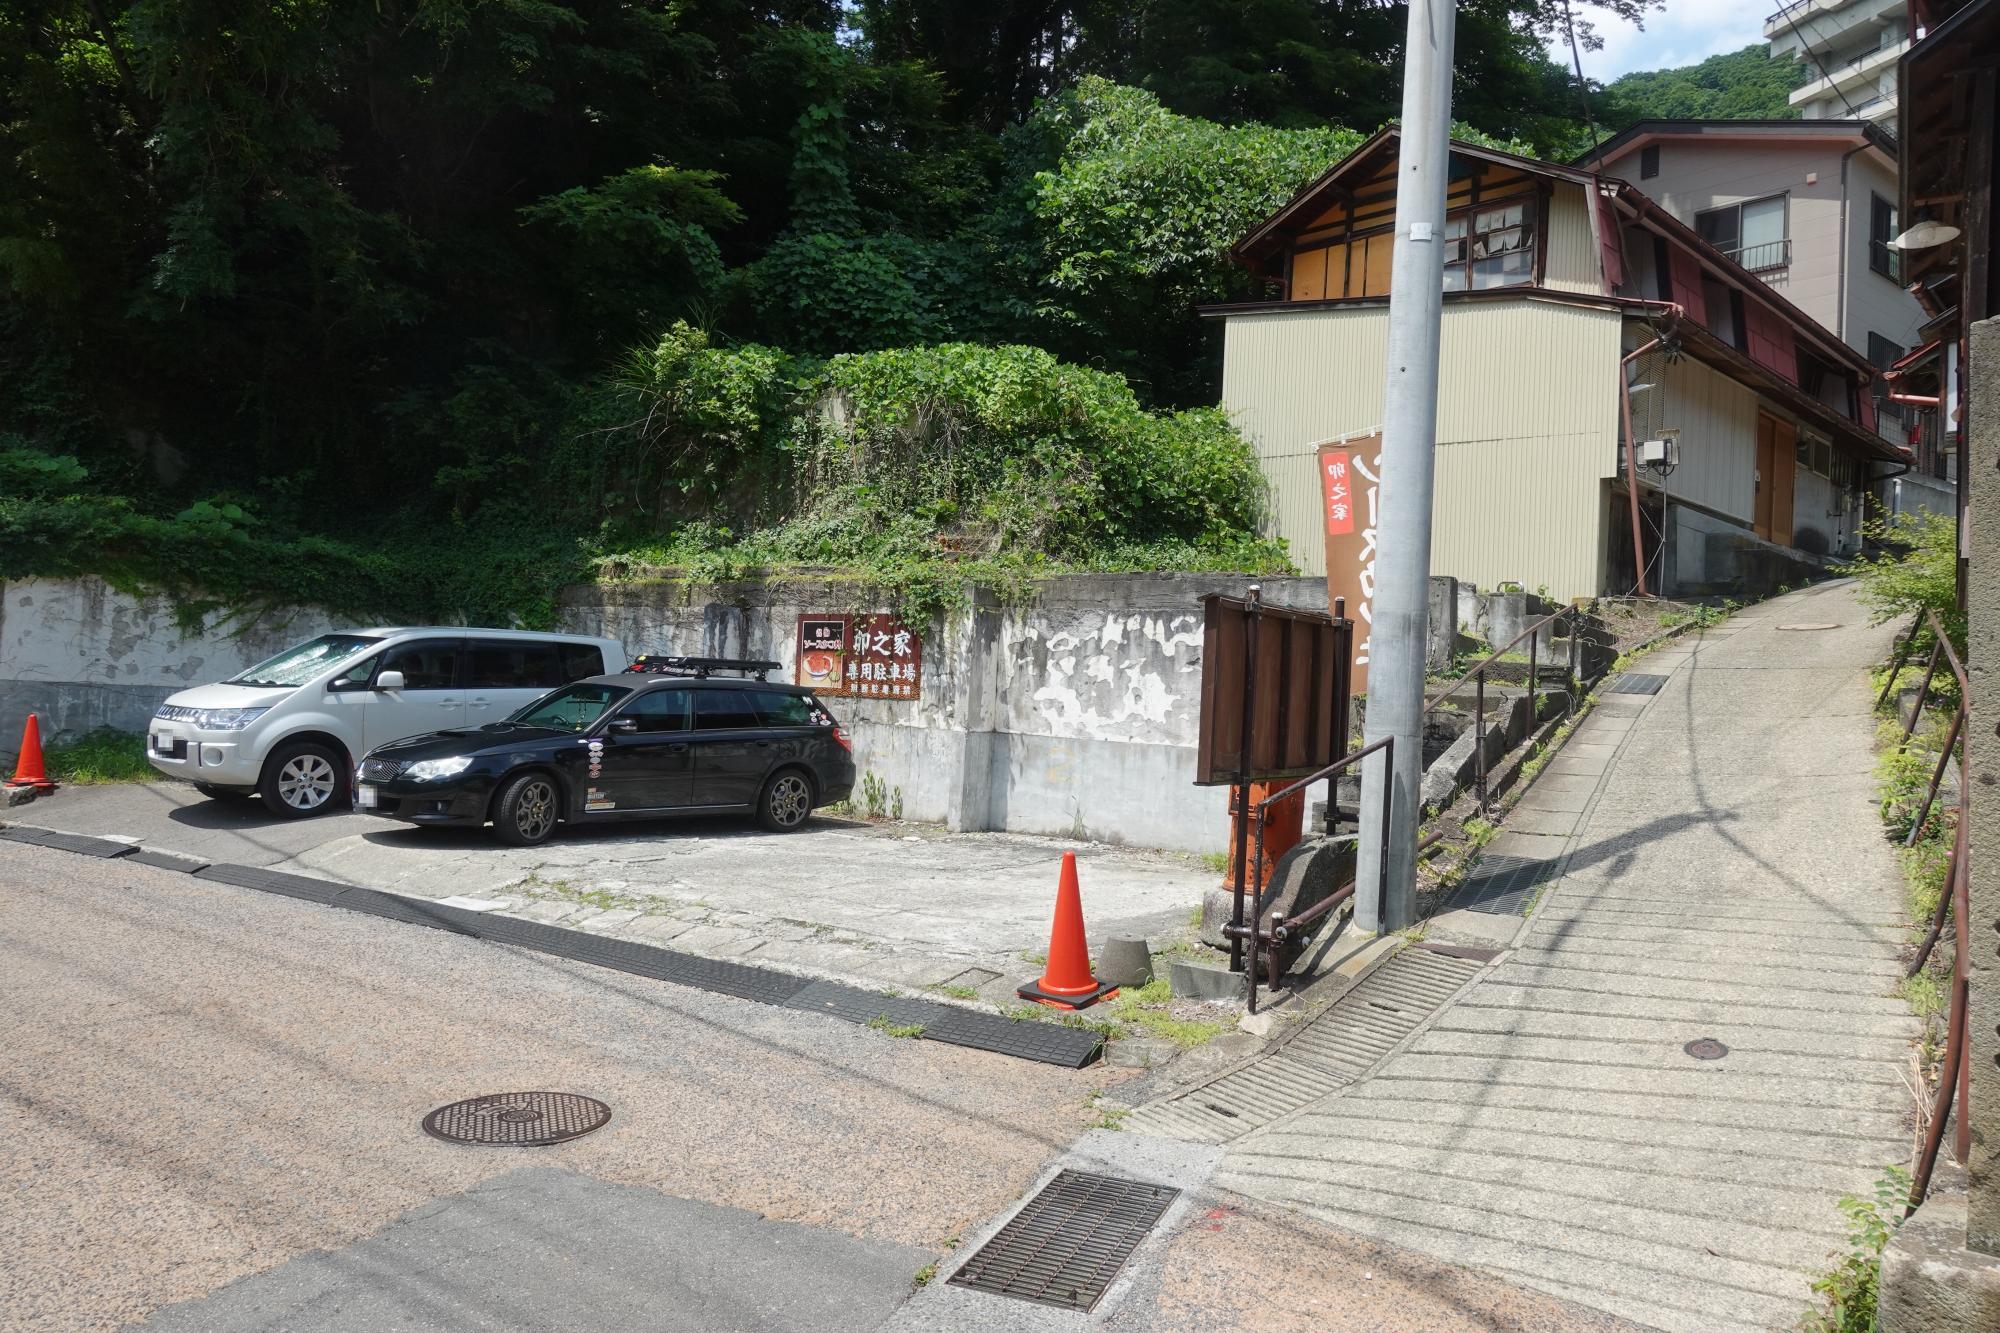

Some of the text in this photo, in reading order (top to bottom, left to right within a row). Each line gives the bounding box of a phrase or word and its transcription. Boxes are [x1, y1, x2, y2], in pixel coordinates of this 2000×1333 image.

[854, 630, 912, 656] 卯之家
[846, 662, 916, 682] 専用駐車場
